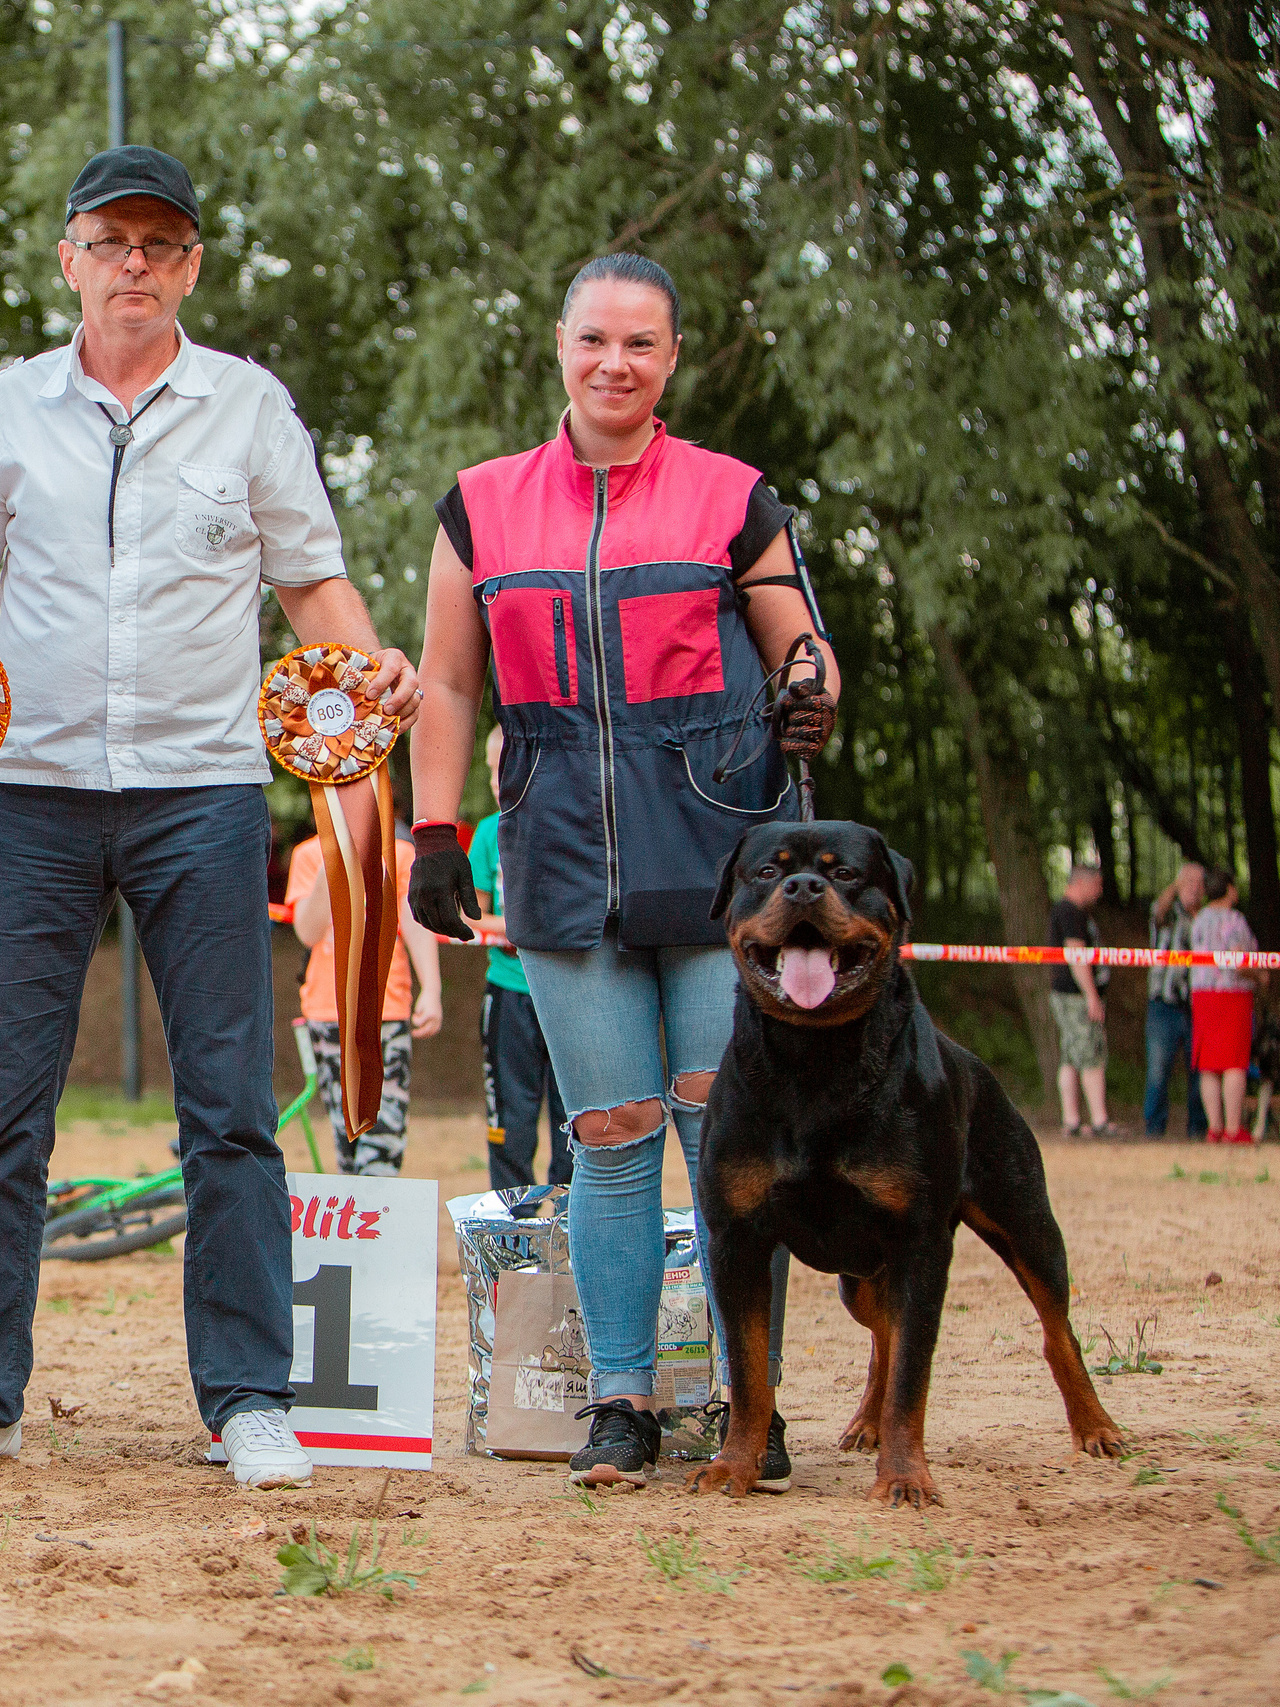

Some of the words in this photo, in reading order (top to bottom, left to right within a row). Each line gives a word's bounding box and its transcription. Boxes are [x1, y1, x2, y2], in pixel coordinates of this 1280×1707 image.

[317, 704, 343, 720] BOS
[1099, 947, 1132, 966] PRO
[1135, 948, 1164, 966] PAC
[664, 1271, 689, 1280] ЕНЮ
[289, 1264, 378, 1411] 1
[685, 1346, 705, 1354] 26/15
